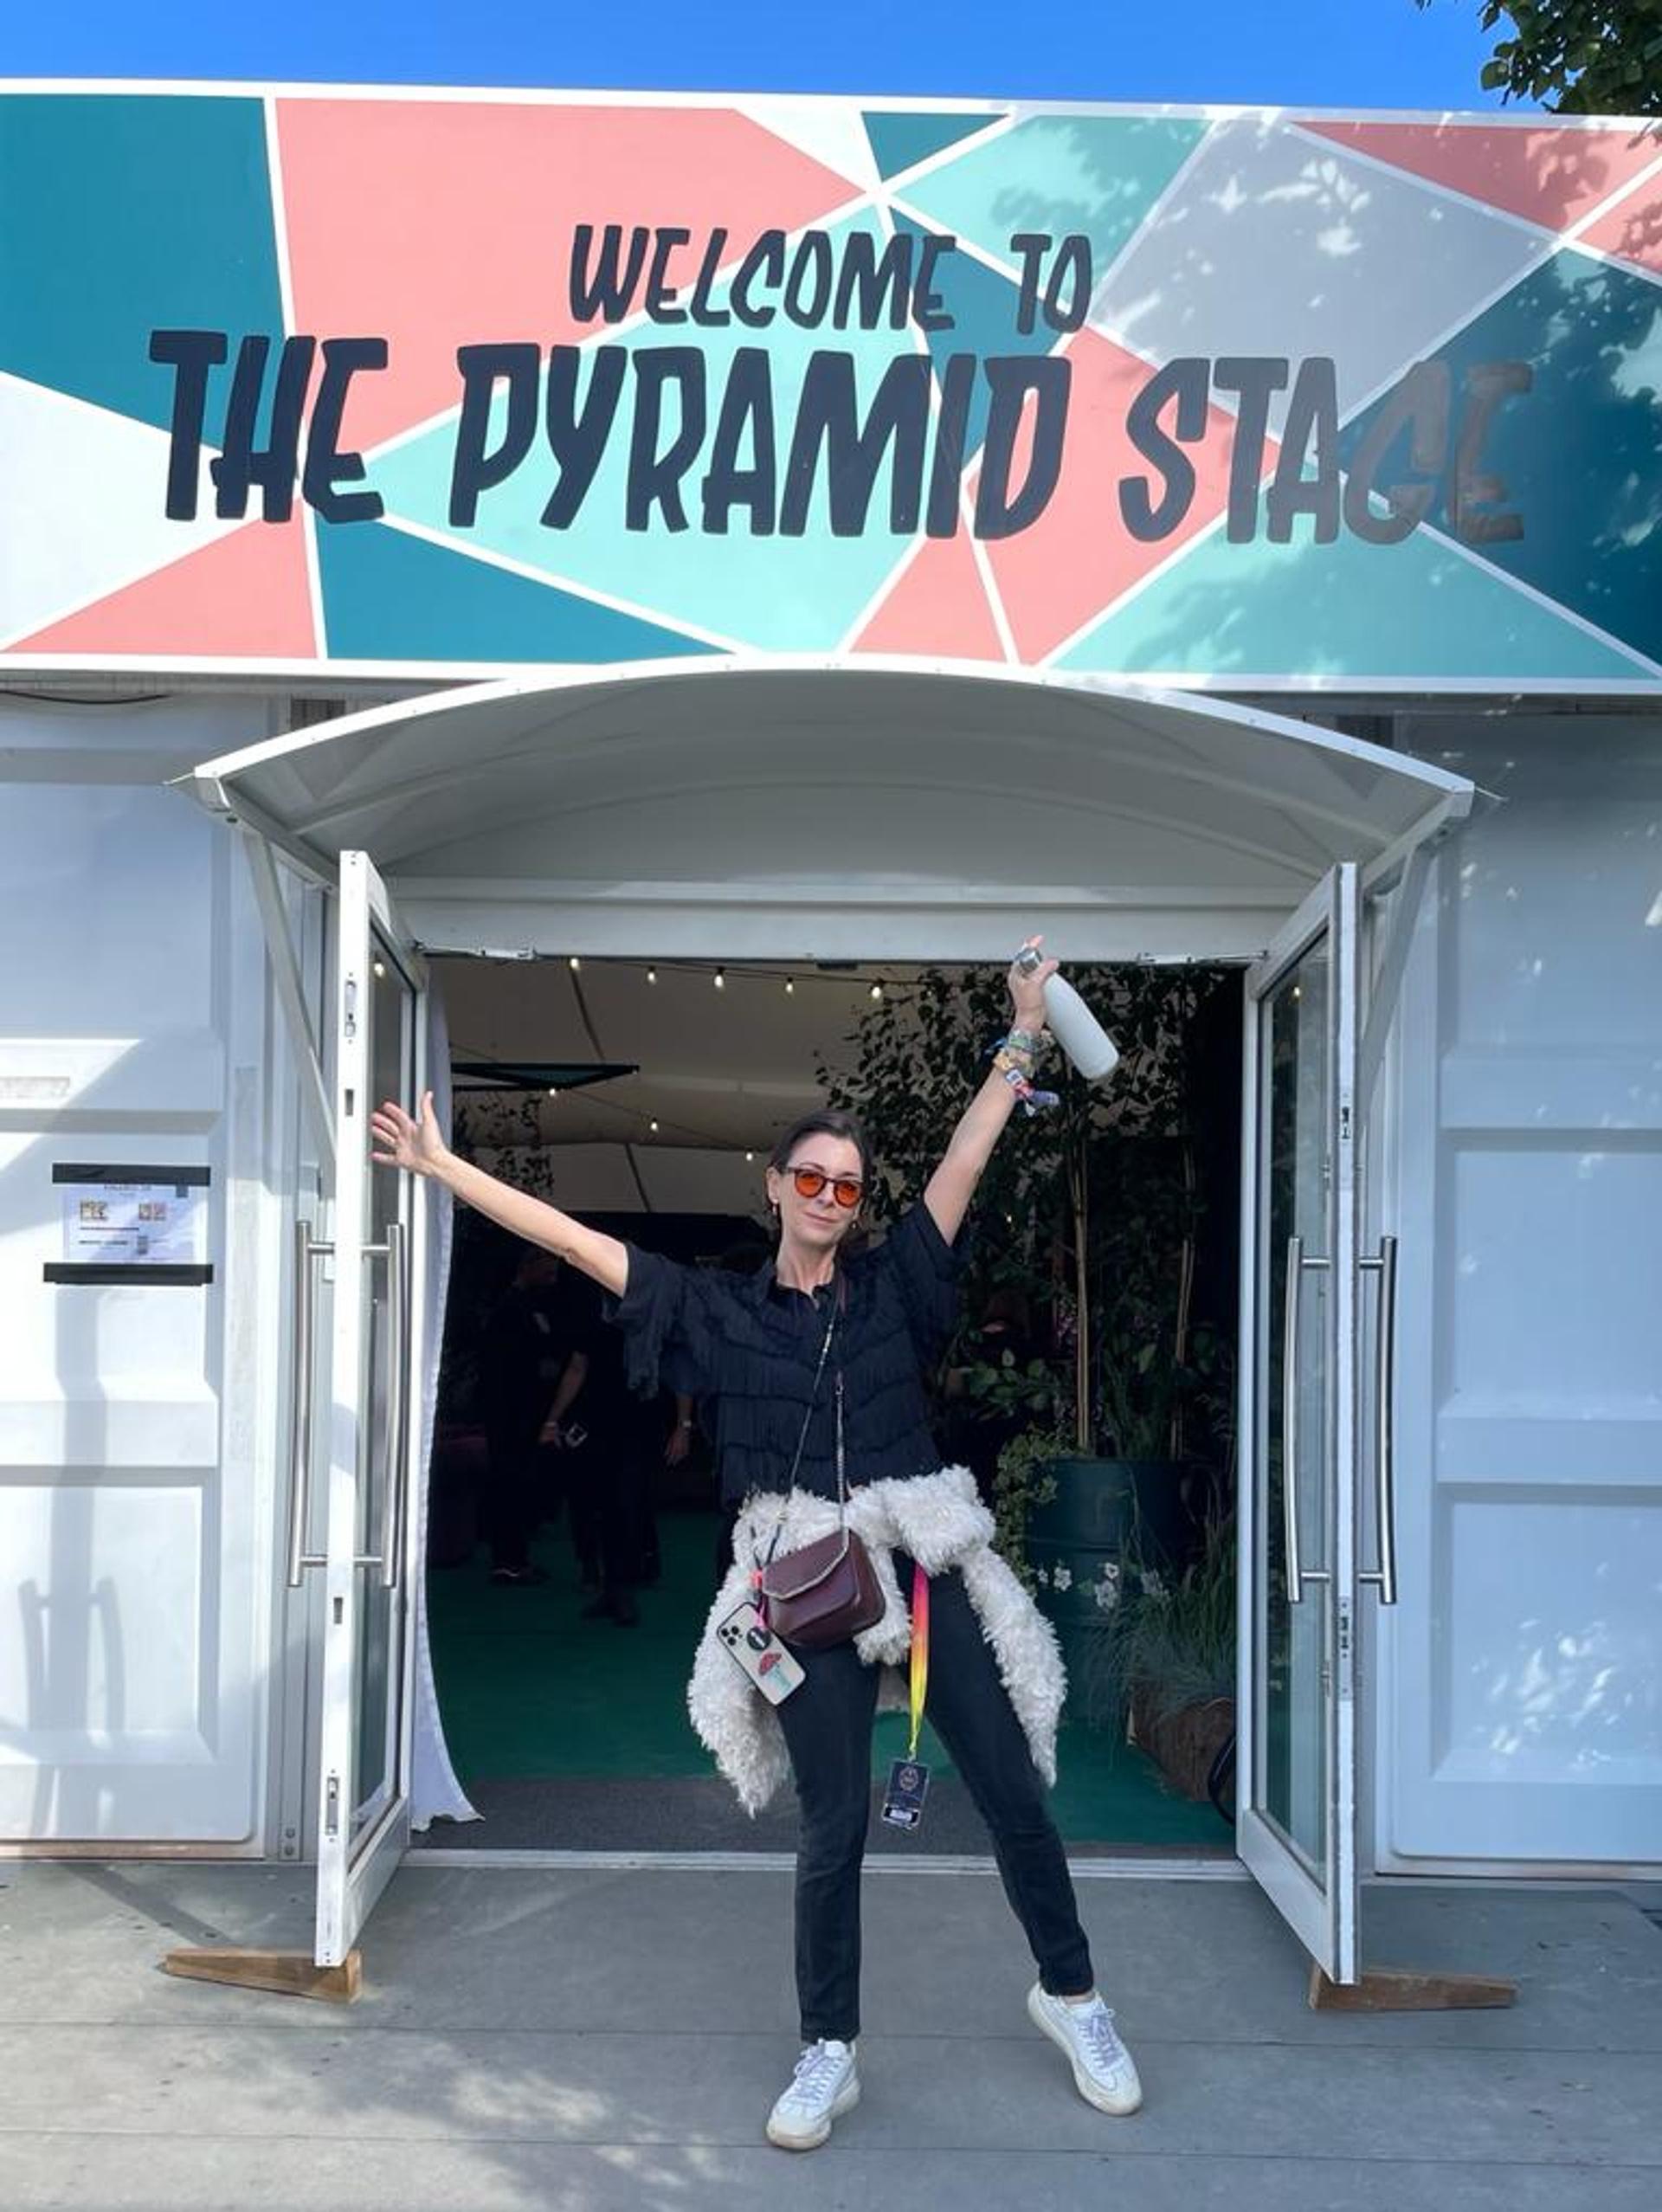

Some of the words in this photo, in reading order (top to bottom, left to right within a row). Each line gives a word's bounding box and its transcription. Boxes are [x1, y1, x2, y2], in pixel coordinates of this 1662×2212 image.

[569, 223, 956, 332] WELCOME
[1010, 233, 1092, 335] TO
[149, 329, 389, 524] THE
[448, 342, 1072, 540] PYRAMID
[1118, 356, 1534, 545] STAGE
